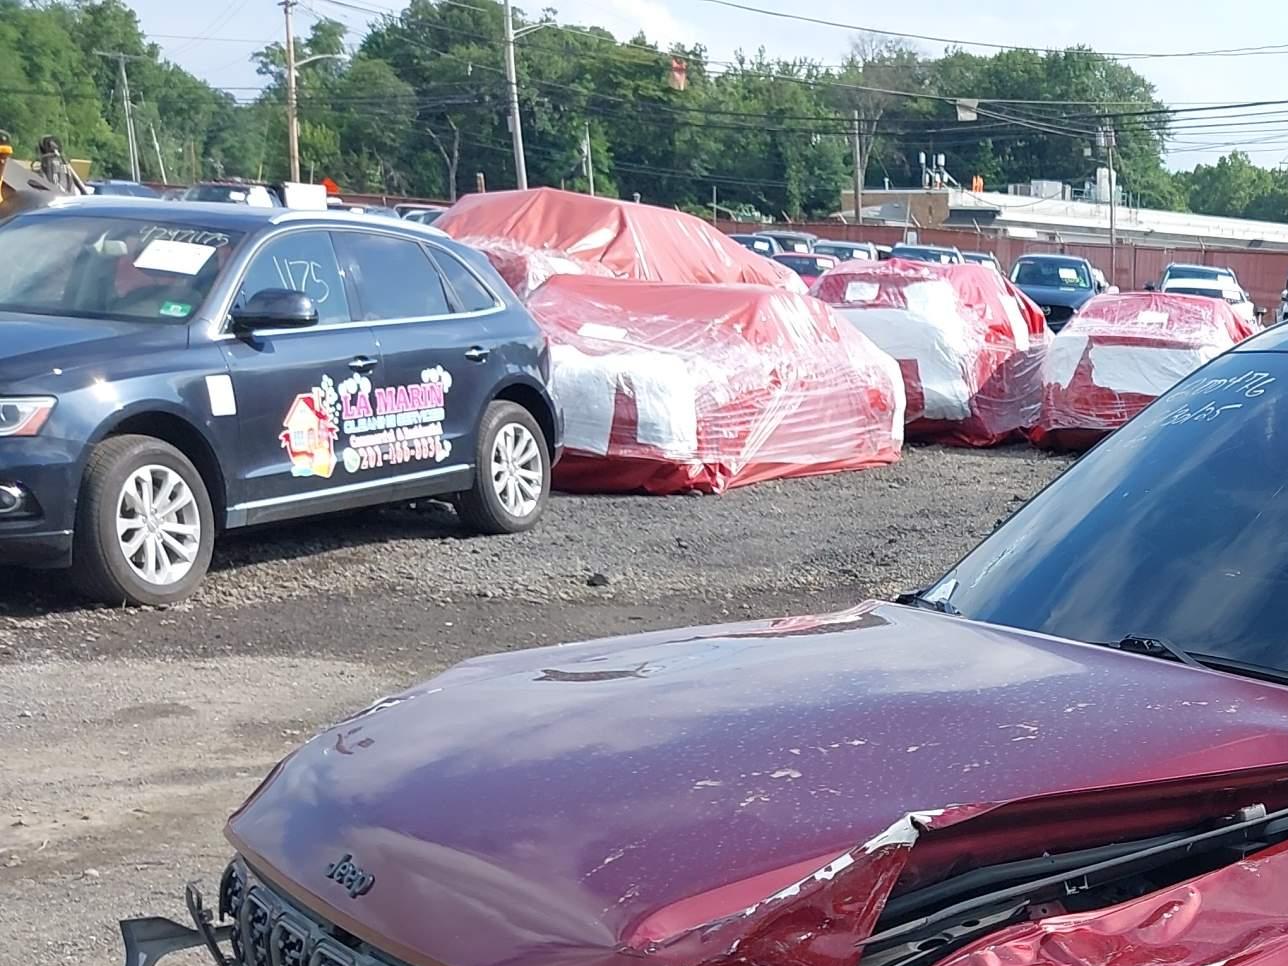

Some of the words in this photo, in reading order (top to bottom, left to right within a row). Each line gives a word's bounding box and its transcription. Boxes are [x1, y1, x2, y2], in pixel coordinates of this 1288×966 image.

[272, 255, 330, 304] 1175
[341, 391, 373, 420] LA
[375, 383, 444, 415] MARIN
[326, 854, 375, 899] Jeep
